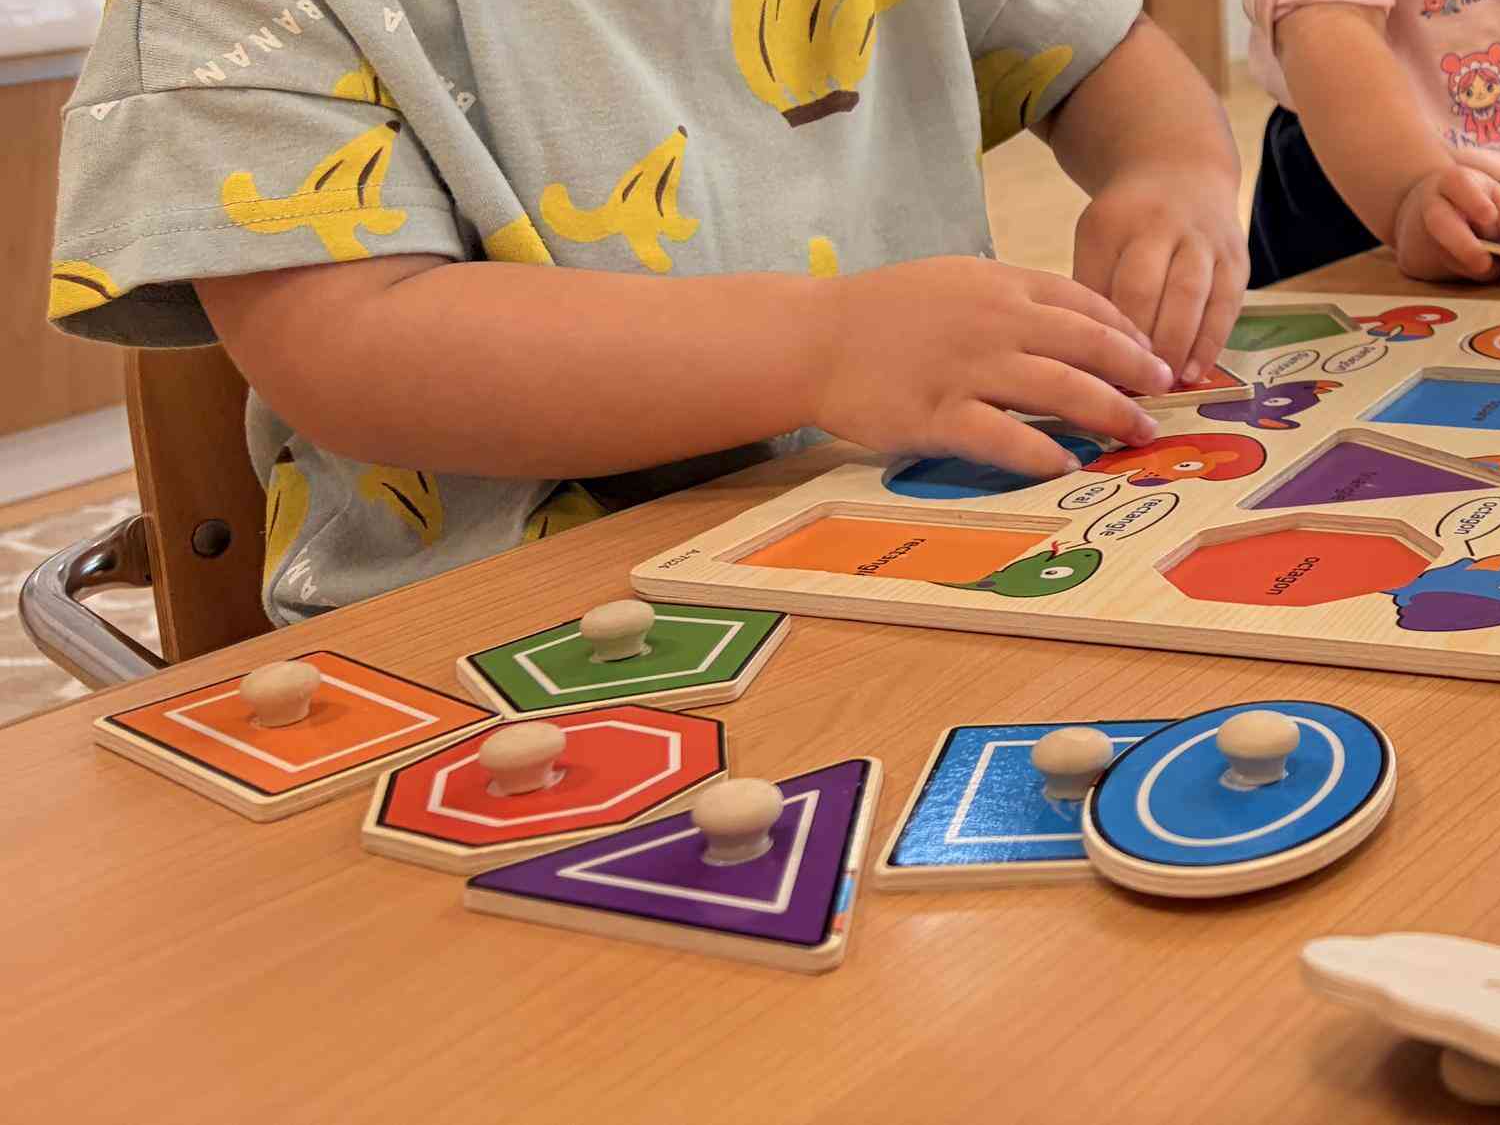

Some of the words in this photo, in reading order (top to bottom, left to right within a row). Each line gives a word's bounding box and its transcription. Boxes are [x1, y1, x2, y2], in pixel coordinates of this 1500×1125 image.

[1072, 486, 1105, 504] oval
[1098, 498, 1163, 537] rectangle
[1454, 501, 1498, 536] octagon
[1264, 556, 1321, 595] octagon
